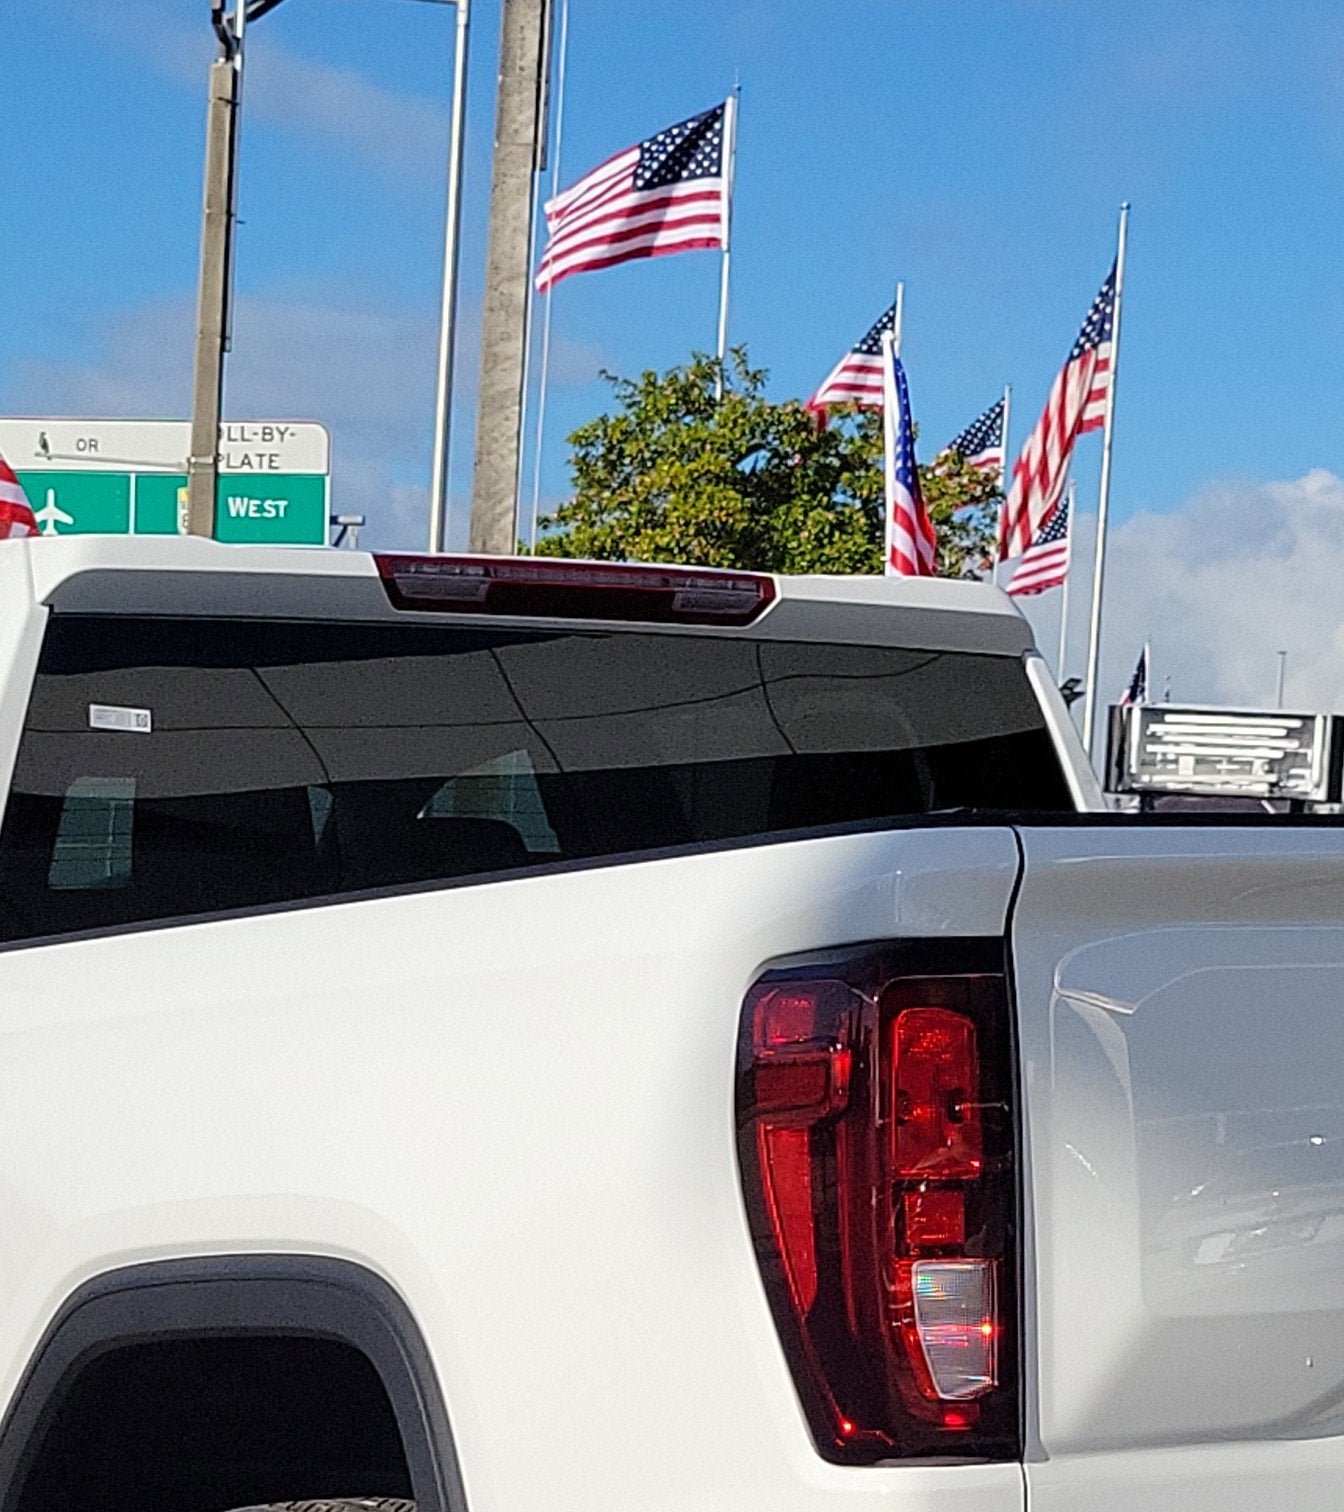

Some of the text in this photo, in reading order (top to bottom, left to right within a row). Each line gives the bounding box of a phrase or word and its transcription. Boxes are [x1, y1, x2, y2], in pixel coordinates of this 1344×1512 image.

[219, 425, 296, 442] LL-BY-
[76, 437, 99, 453] OR
[227, 496, 289, 518] WEST
